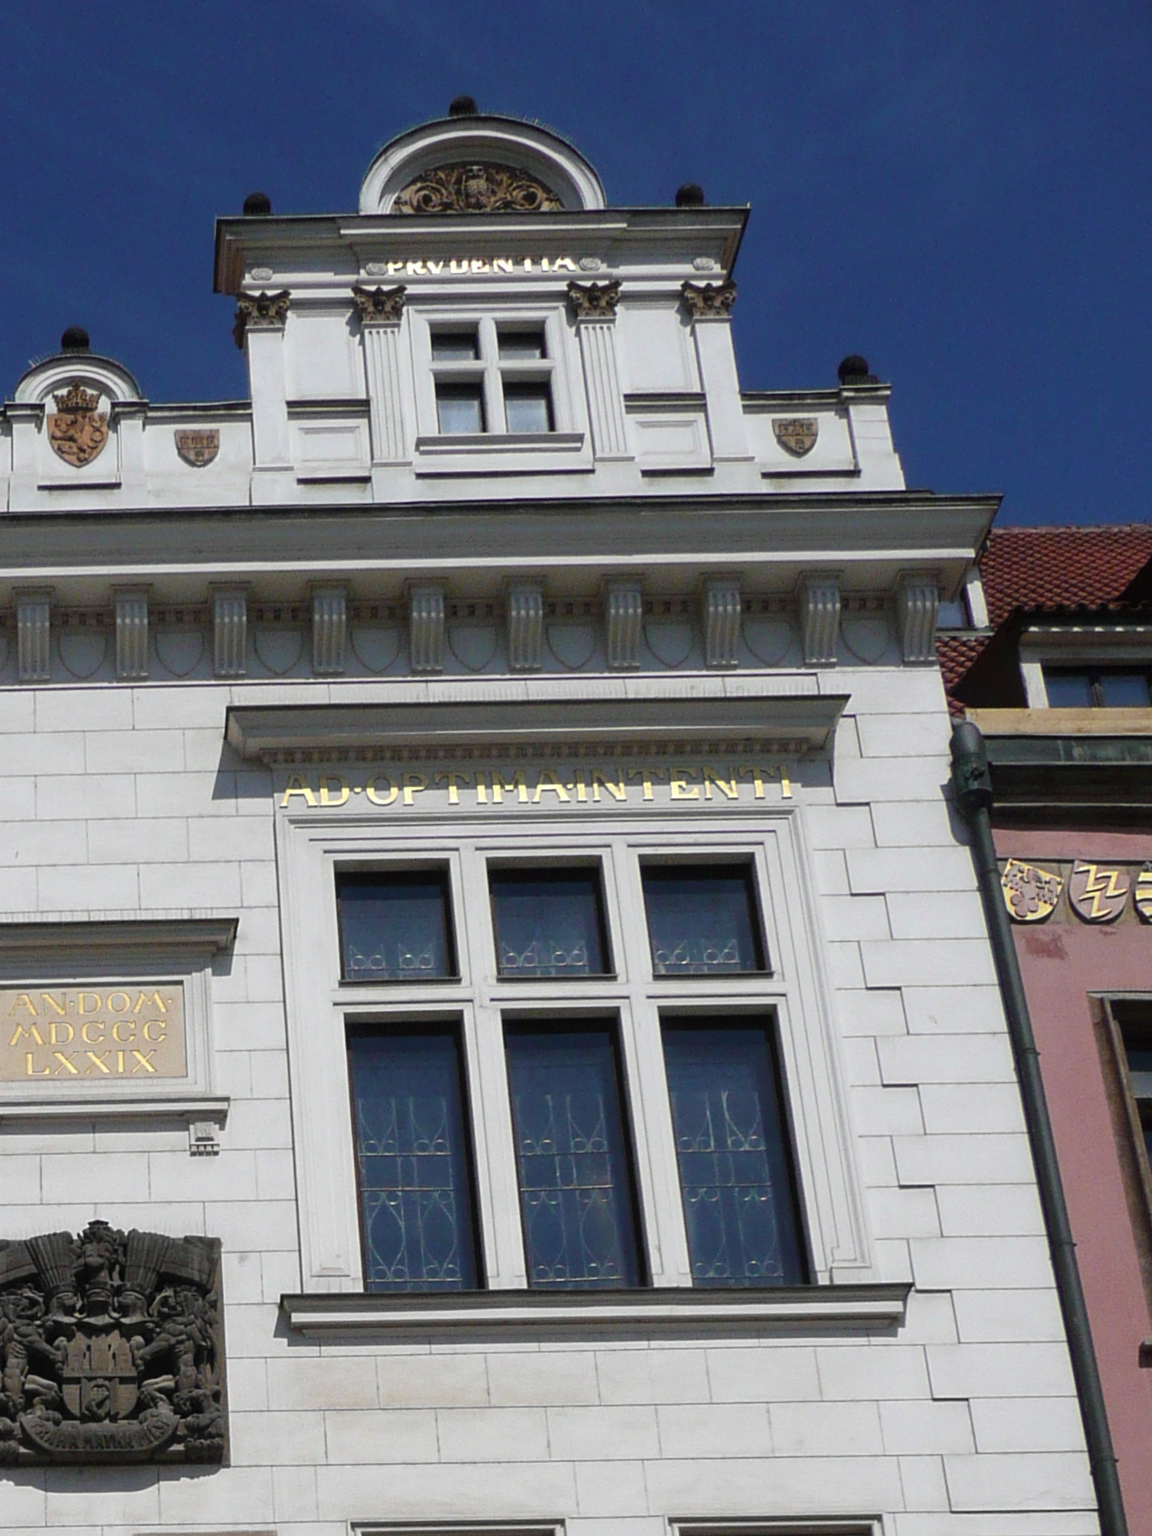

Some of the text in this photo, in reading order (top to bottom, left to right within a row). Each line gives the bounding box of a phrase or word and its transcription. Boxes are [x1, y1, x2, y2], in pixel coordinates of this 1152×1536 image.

[386, 256, 577, 275] PRVDENTIA
[9, 1020, 168, 1046] MDCCC
[25, 1049, 158, 1076] LXXIX
